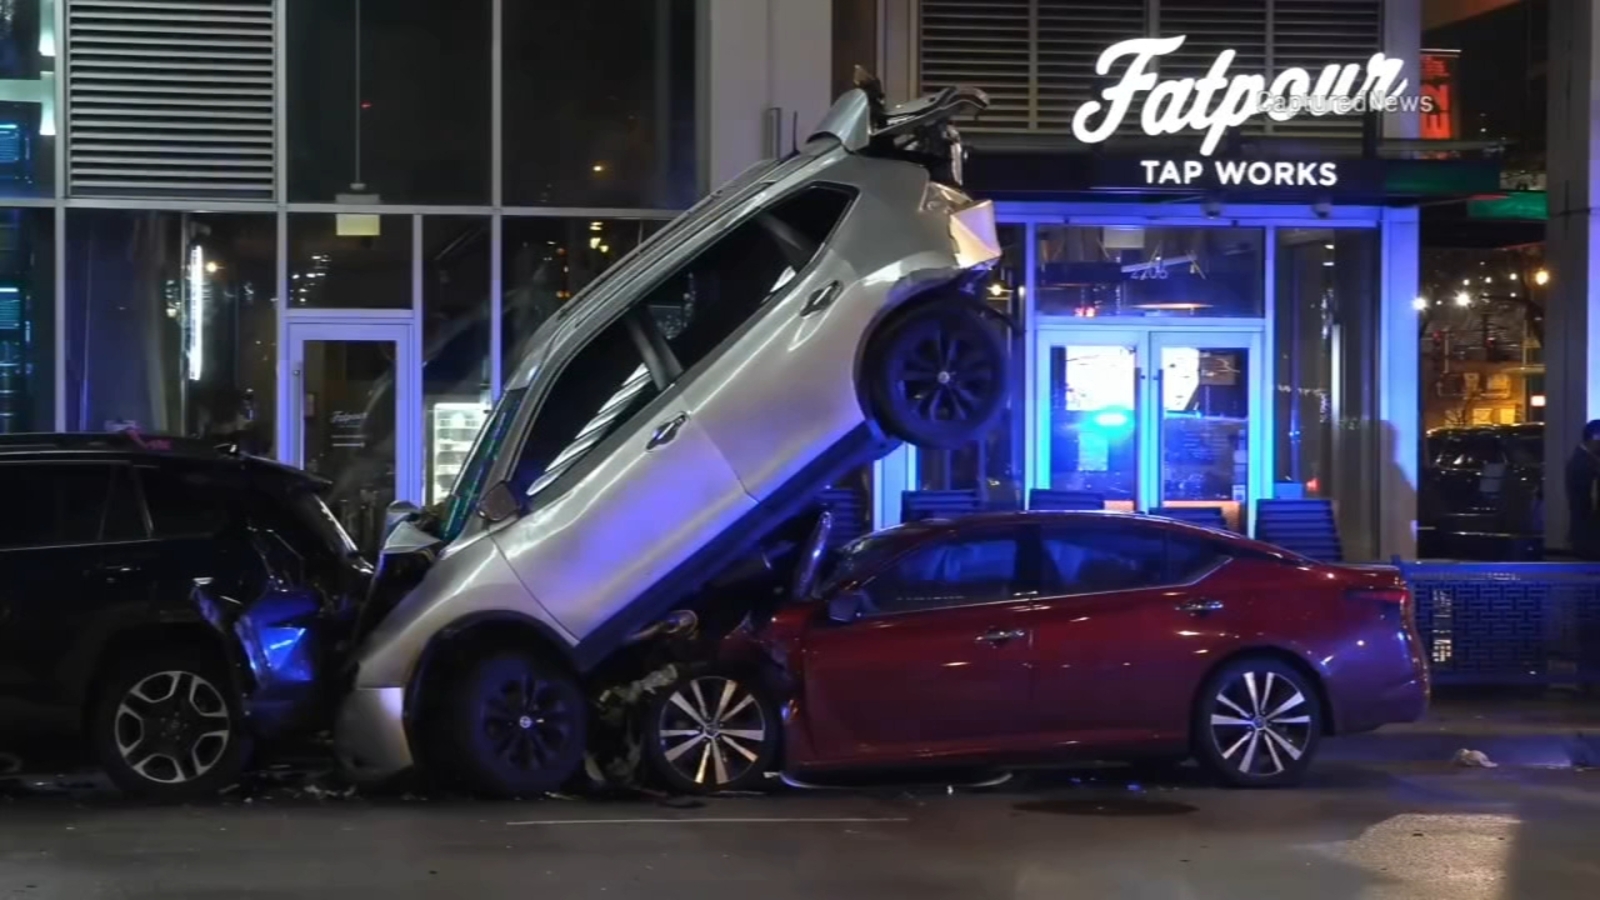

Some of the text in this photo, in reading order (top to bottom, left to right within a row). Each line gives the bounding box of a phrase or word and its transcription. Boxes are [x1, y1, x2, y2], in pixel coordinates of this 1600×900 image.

[1072, 36, 1408, 156] Fatpour
[1141, 160, 1338, 187] TAP WORKS
